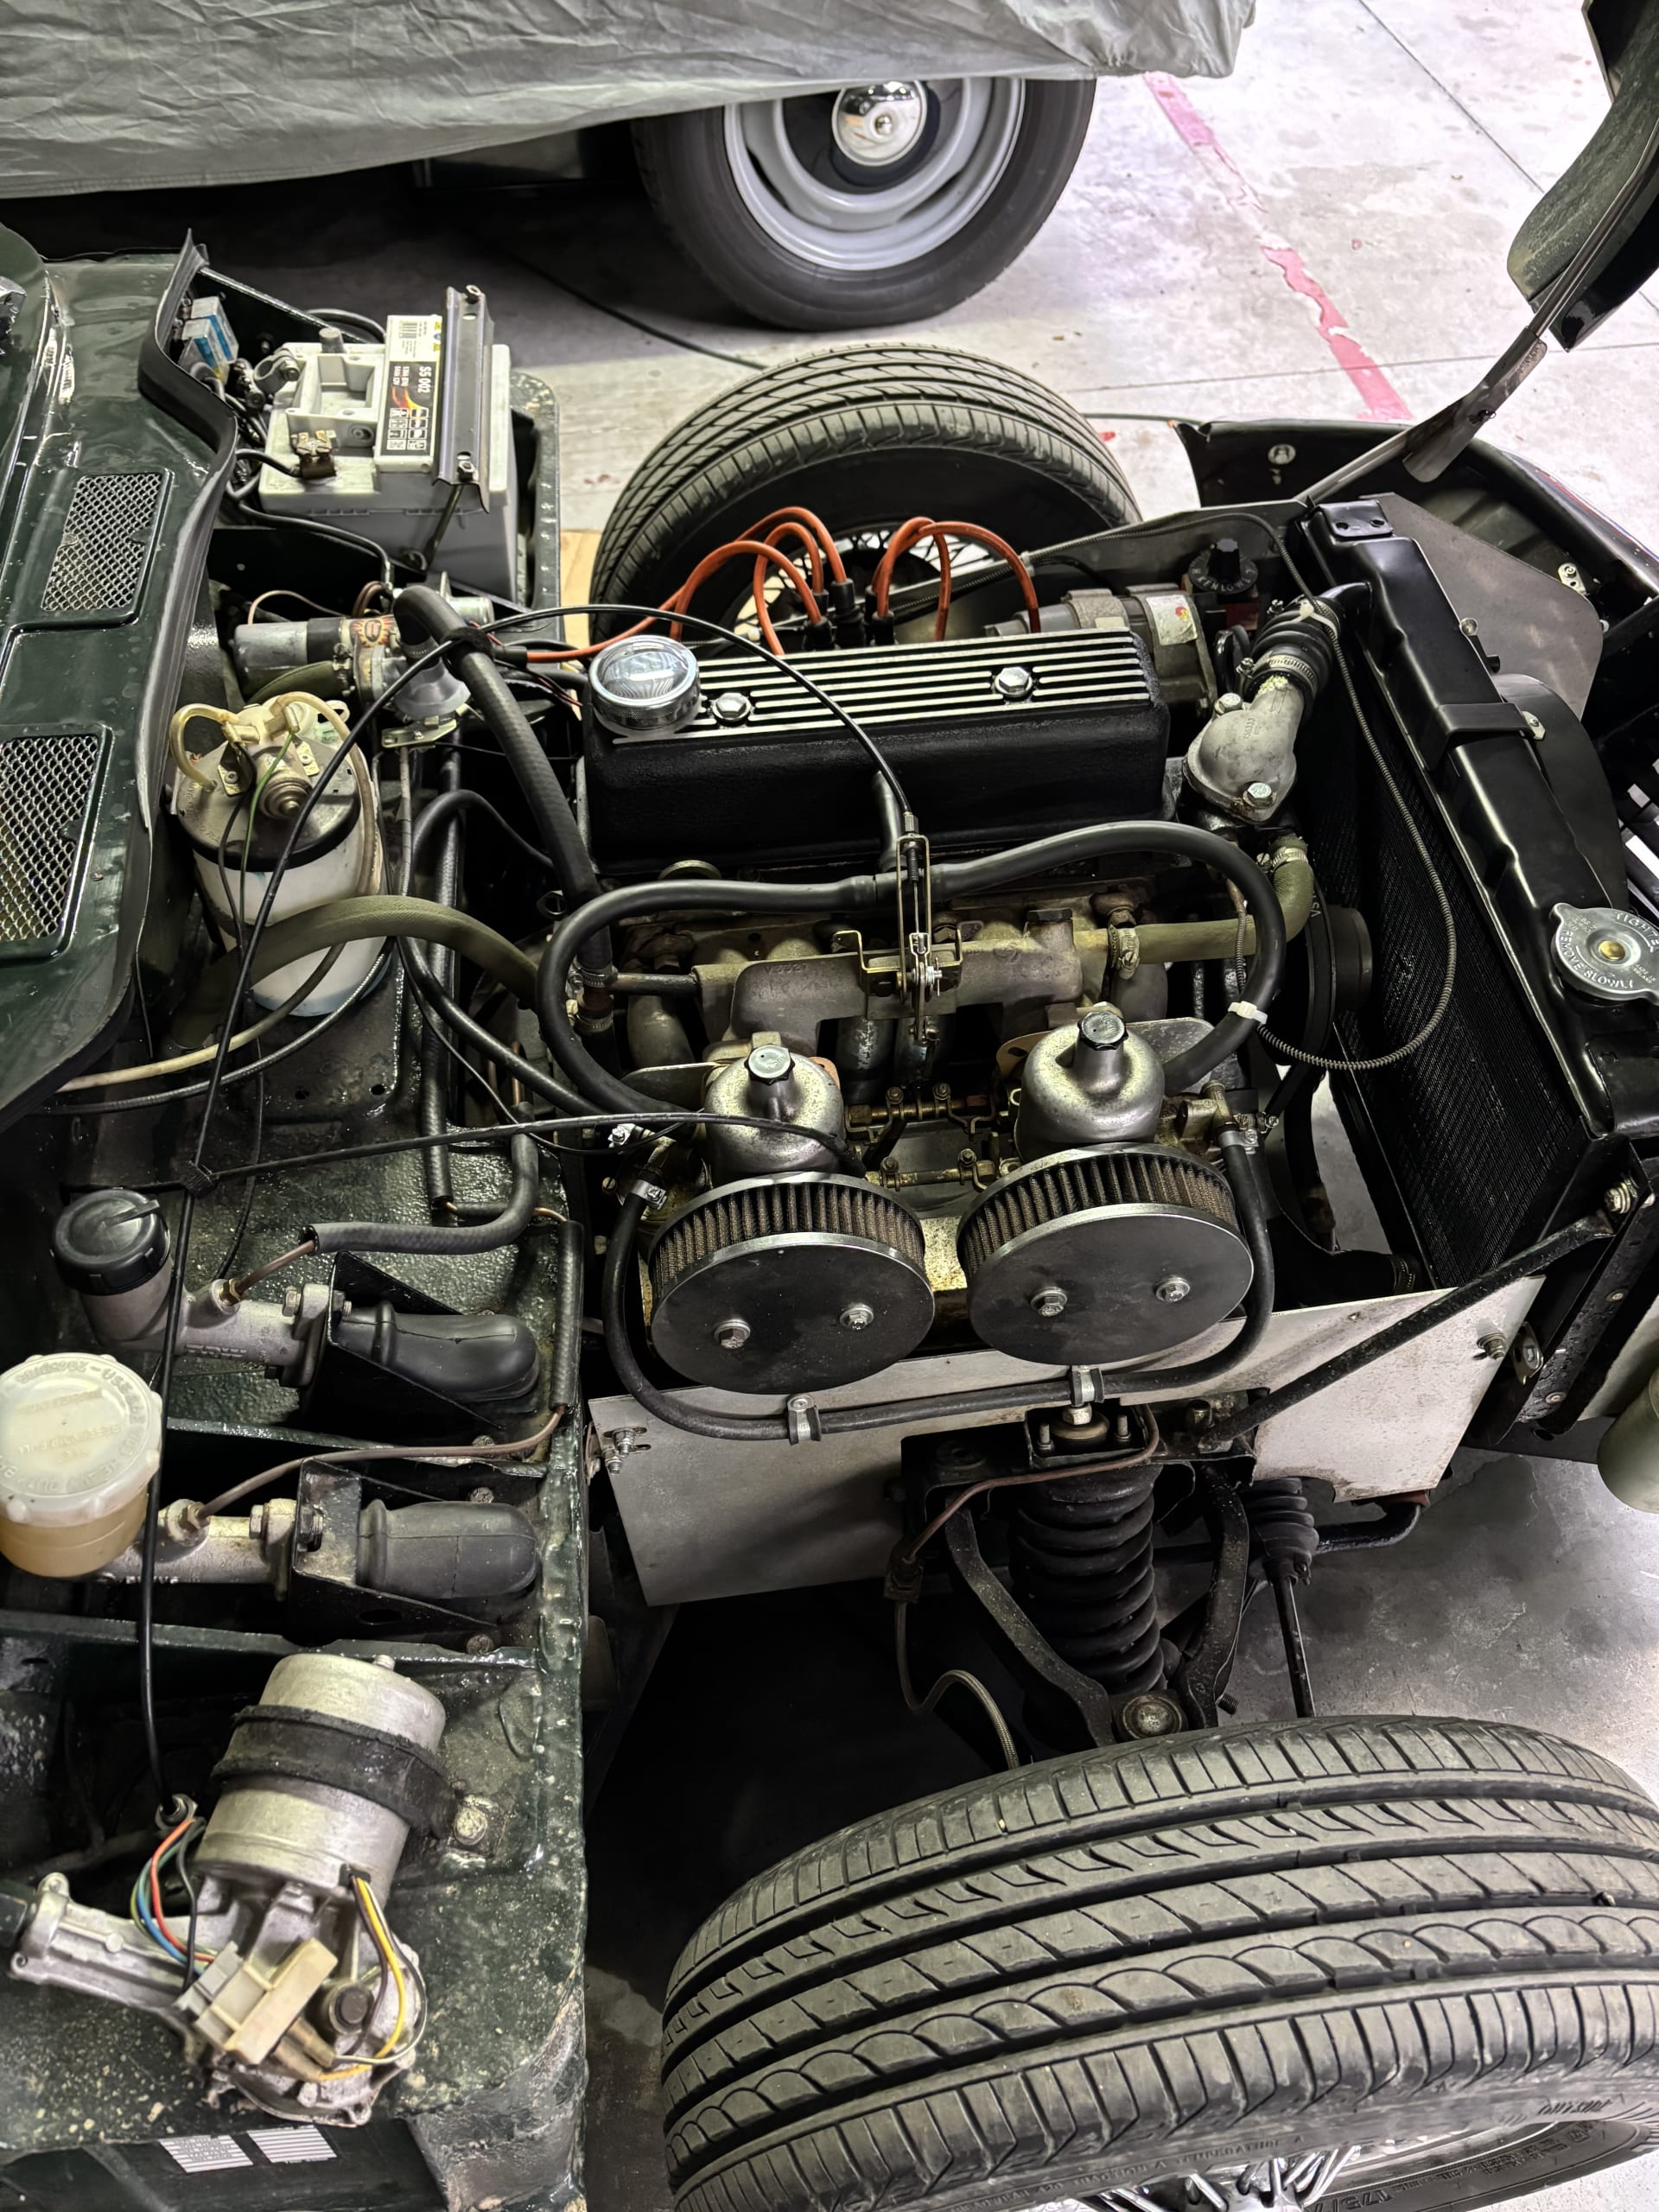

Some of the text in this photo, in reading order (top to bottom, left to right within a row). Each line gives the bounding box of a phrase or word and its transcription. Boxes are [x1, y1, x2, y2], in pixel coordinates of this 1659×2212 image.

[417, 366, 431, 393] S5 002
[1197, 575, 1251, 592] KENLOWE
[1615, 912, 1659, 948] TIGHTE
[1560, 930, 1634, 988] REMOVE SLOWLY
